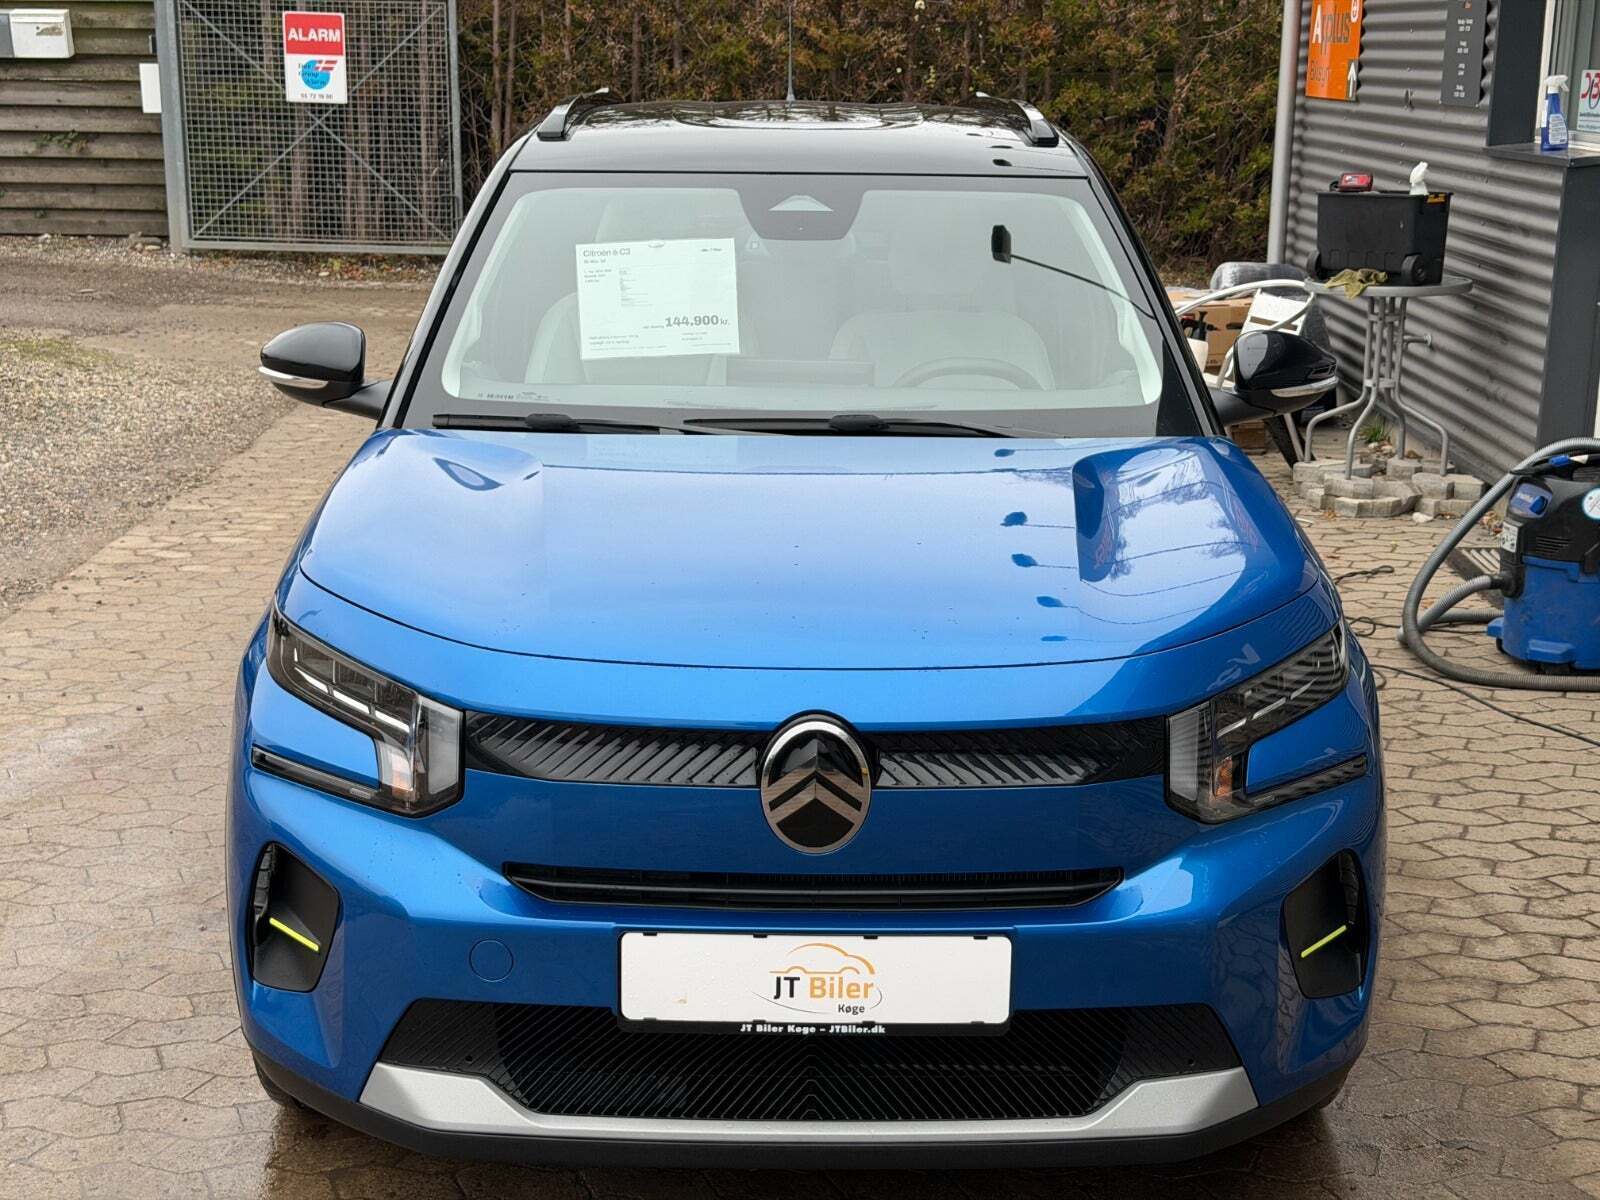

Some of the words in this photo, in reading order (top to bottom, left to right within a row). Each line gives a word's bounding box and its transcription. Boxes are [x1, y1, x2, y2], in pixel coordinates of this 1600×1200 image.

[287, 27, 341, 42] ALARM
[665, 315, 719, 328] 144.900
[773, 976, 800, 999] JT
[809, 976, 875, 999] Biler
[838, 1003, 866, 1015] Køge
[740, 1024, 753, 1033] JT
[756, 1024, 784, 1033] Biler
[829, 1024, 886, 1034] JTBiler.dk
